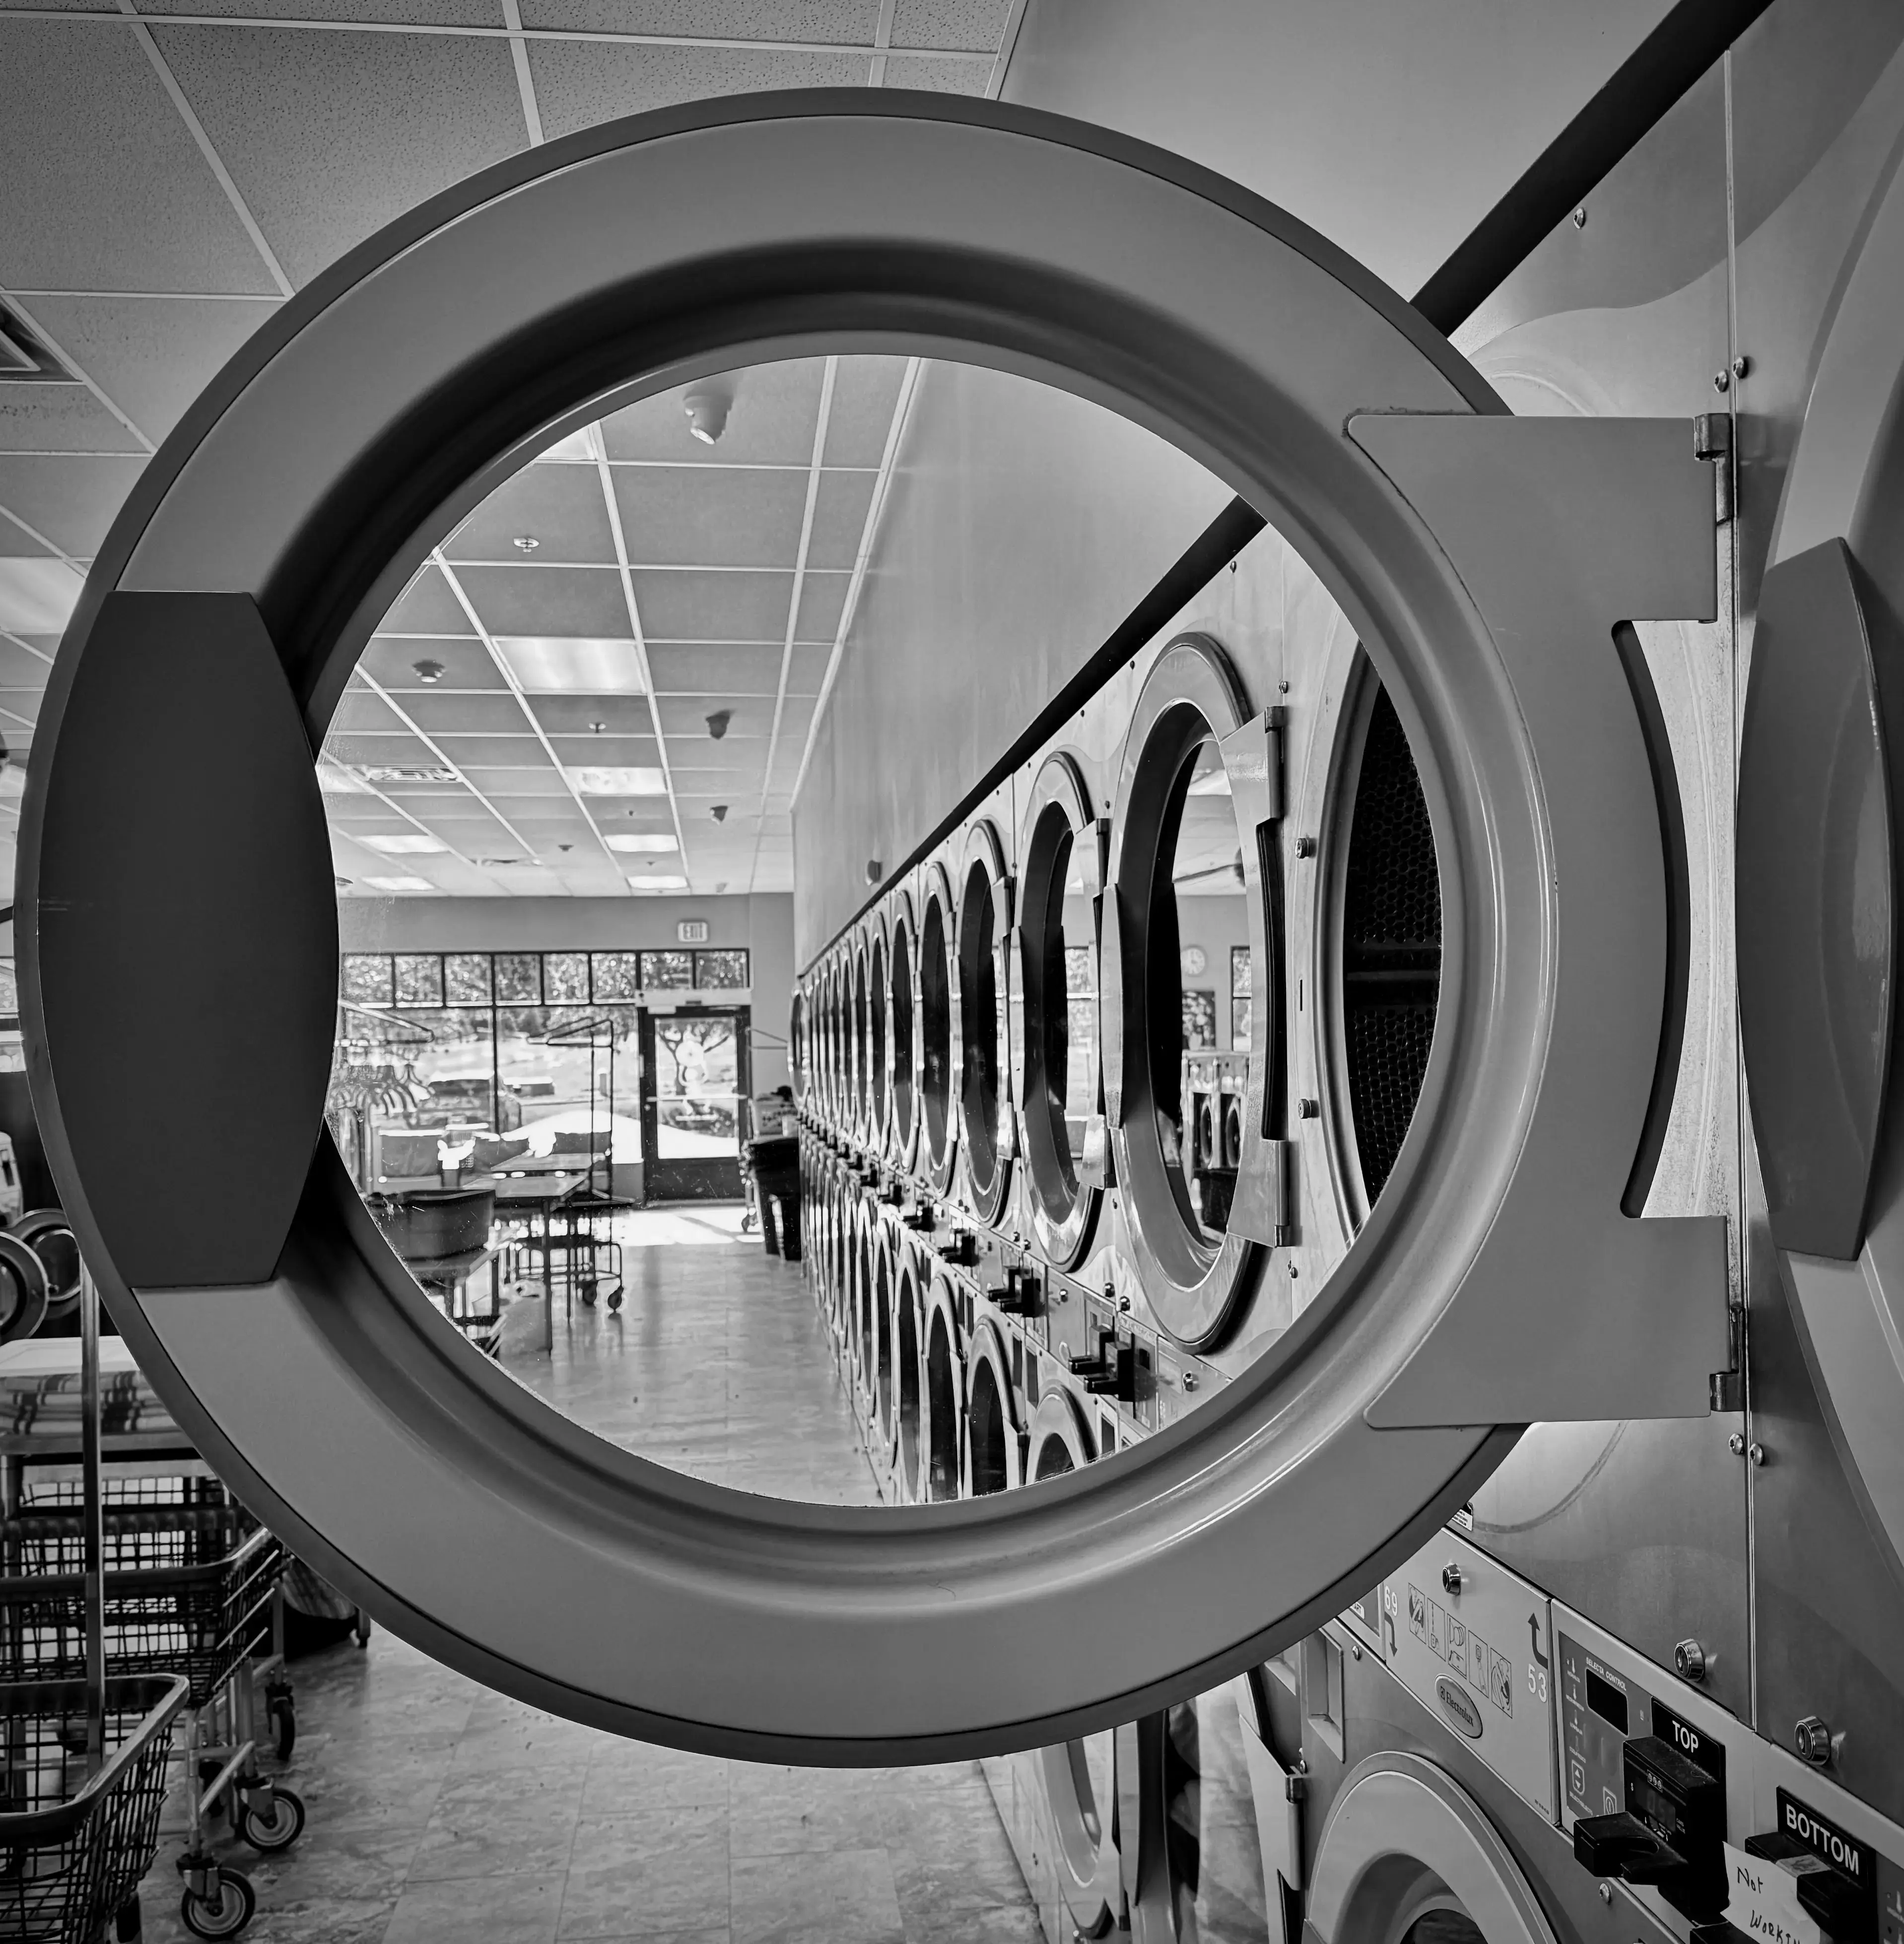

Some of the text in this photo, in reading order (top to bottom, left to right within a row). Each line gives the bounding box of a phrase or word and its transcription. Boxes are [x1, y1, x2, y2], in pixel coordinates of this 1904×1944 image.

[1385, 1585, 1398, 1616] 69
[1528, 1664, 1547, 1702] 53
[1586, 1657, 1627, 1691] SELECTA CONTROL
[1446, 1691, 1474, 1727] Electrolux
[1672, 1720, 1699, 1753] TOP
[1786, 1803, 1859, 1876] BOTTOM
[1737, 1866, 1763, 1894] Not
